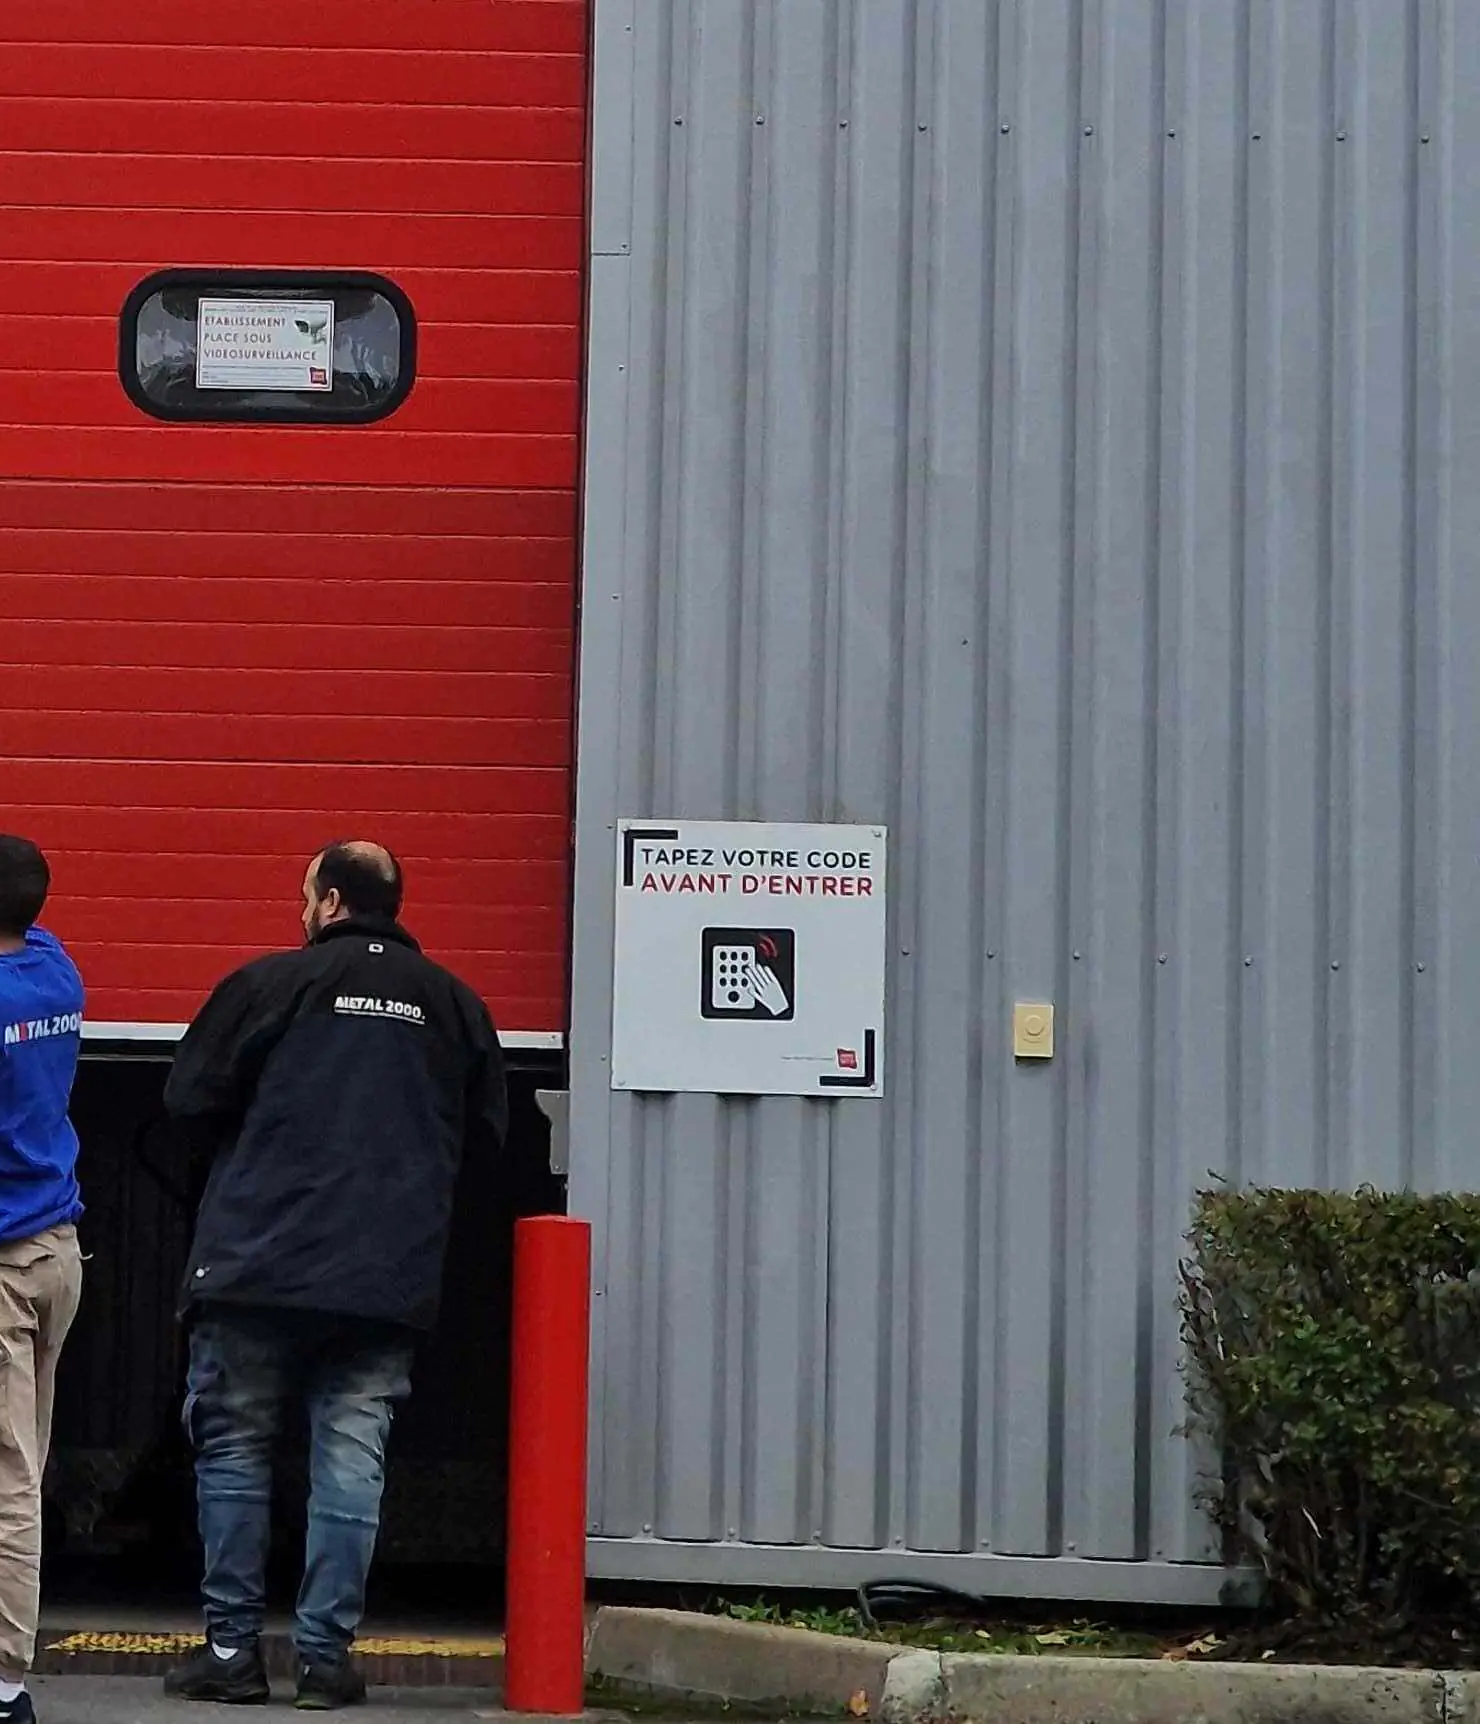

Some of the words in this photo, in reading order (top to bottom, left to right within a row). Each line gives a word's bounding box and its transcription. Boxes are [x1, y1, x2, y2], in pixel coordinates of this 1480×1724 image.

[244, 333, 272, 344] SOUS
[204, 349, 317, 361] VIDEOSURVEILLANCE
[641, 848, 715, 866] TAPEZ
[722, 849, 800, 868] VOTRE
[807, 851, 871, 869] CODE
[641, 873, 732, 894] AVANT
[742, 874, 873, 896] D'ENTRER
